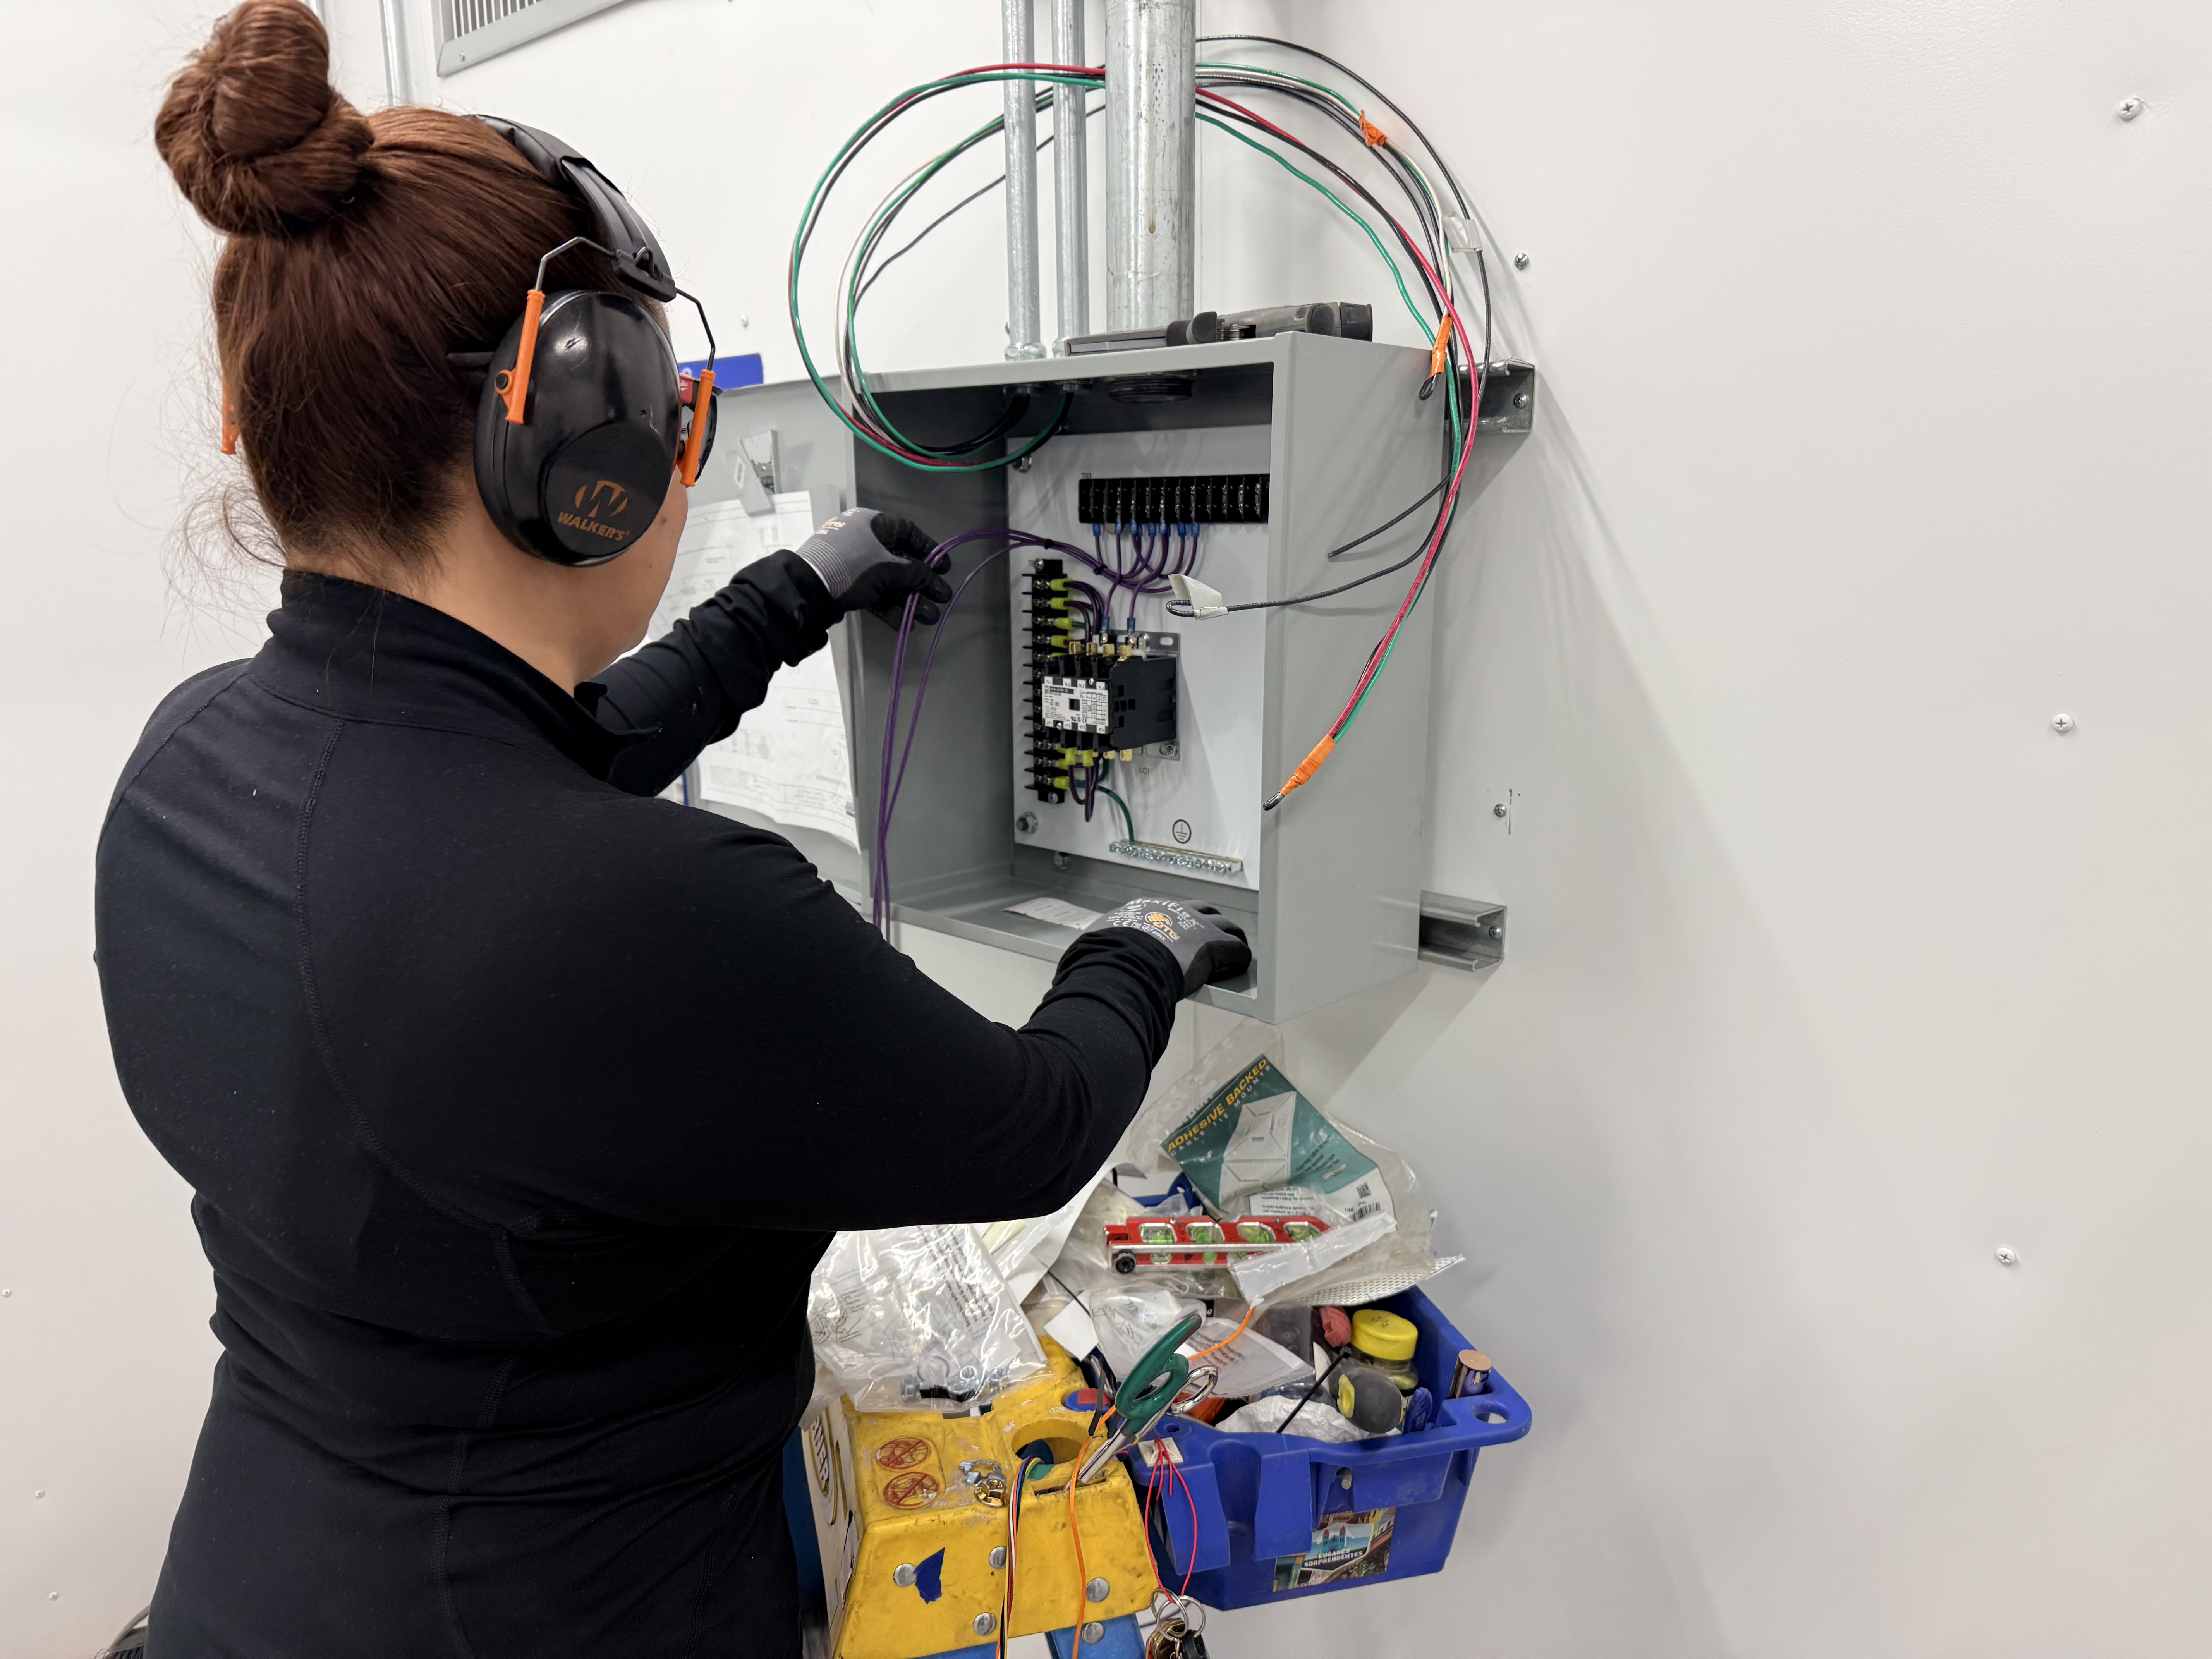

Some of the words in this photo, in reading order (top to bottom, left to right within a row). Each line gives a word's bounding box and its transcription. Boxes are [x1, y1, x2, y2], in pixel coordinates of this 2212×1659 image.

[557, 511, 629, 541] WALKER'S
[1168, 1103, 1226, 1152] ADHESIVE
[1226, 1059, 1267, 1106] BACKED
[1171, 1131, 1205, 1156] CABLE
[1212, 1113, 1229, 1126] TIE
[1233, 1065, 1271, 1108] MOUNTS
[955, 1302, 963, 1312] bolt
[1304, 1550, 1364, 1567] SORPRENDENTES
